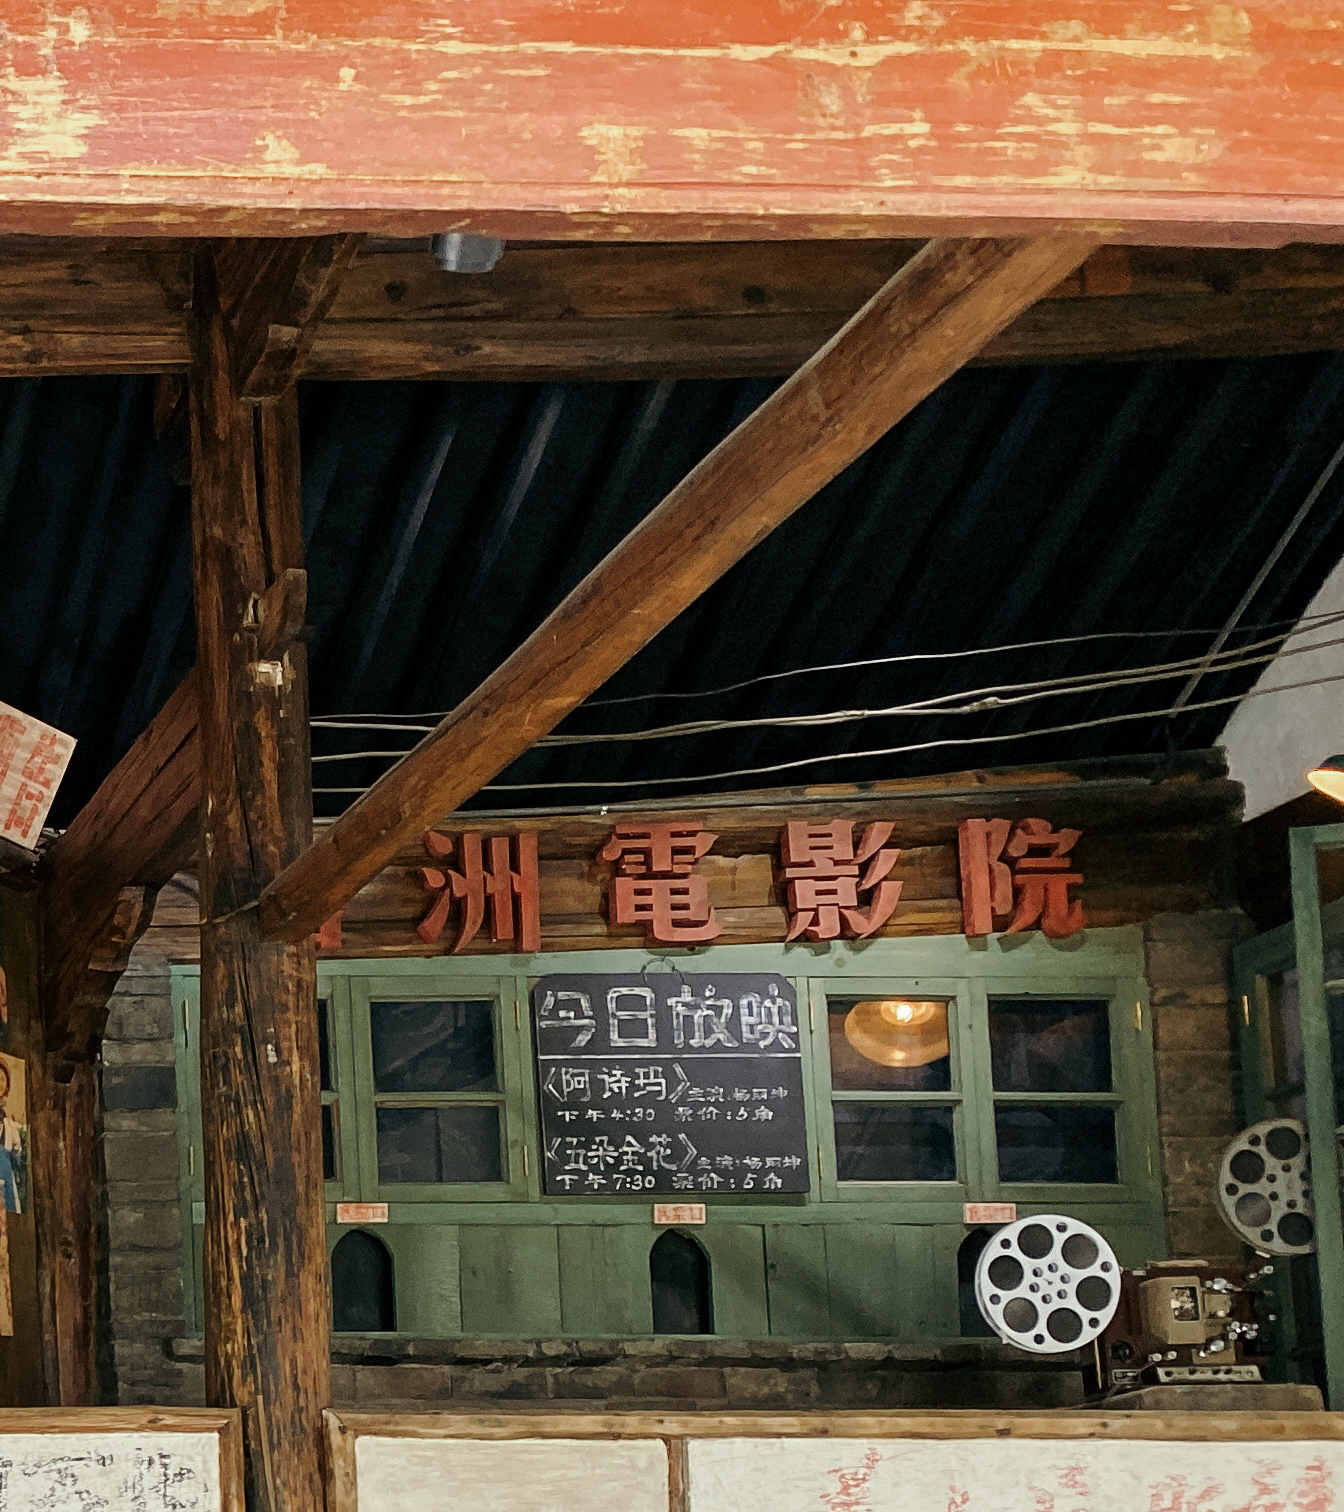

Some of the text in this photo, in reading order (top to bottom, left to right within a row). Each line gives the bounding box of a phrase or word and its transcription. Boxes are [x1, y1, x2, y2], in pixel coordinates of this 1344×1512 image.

[417, 817, 1090, 953] 洲電影院
[540, 983, 798, 1049] 今日放映
[543, 1062, 691, 1103] 《阿诗玛》
[558, 1107, 656, 1122] 下午4:30
[547, 1132, 698, 1172] 《五朵金花》
[556, 1173, 657, 1189] 下午7:30
